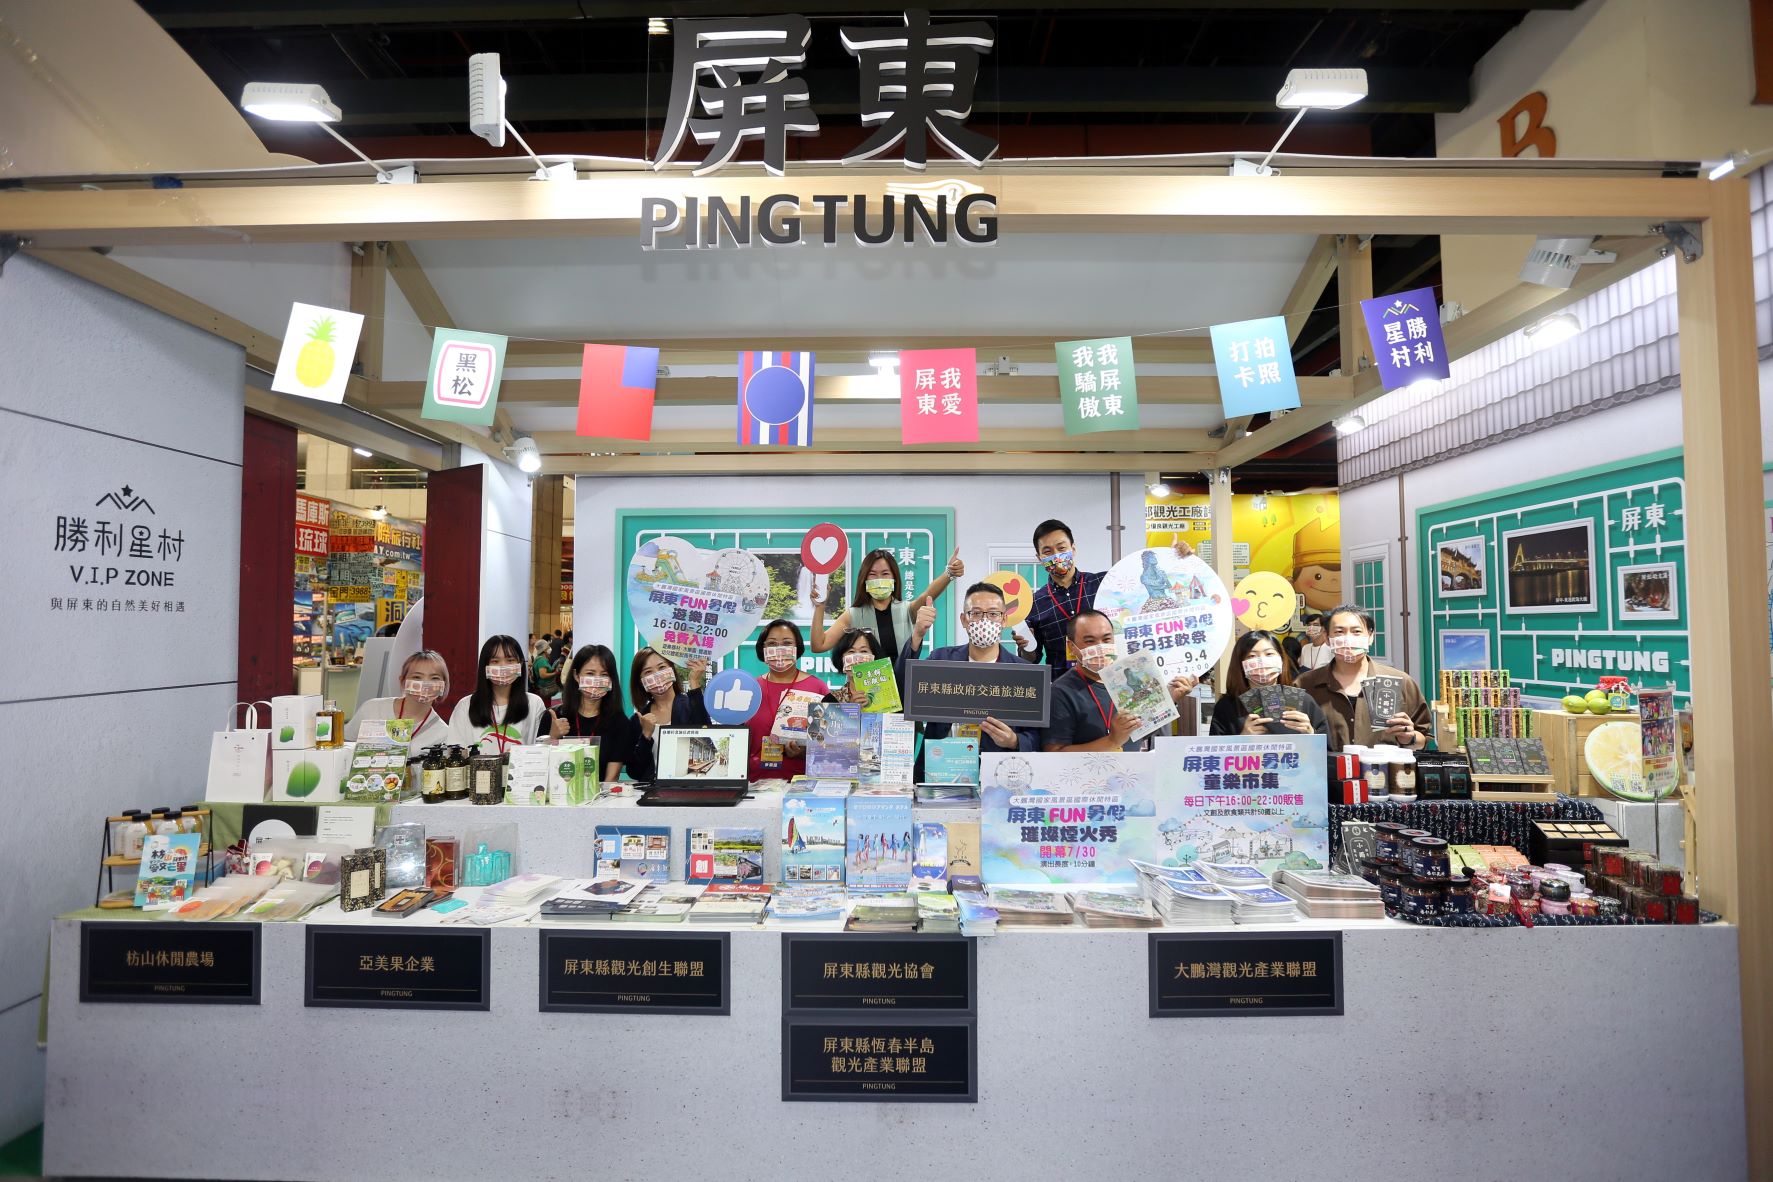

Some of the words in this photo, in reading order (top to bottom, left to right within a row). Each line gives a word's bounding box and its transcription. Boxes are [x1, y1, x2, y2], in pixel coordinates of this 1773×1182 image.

[653, 8, 1000, 177] 屏東
[451, 352, 477, 397] 黑松
[1622, 503, 1667, 532] 屏東
[55, 515, 185, 562] 勝利星村
[295, 528, 328, 554] 琉球
[375, 521, 423, 550] 際旅行社
[70, 565, 118, 586] V.I.P
[125, 569, 175, 586] ZONE
[51, 597, 186, 613] 與屏東的自然美好相遇
[663, 630, 715, 648] 免費入場
[1551, 648, 1669, 673] PINGTUNG
[917, 681, 1037, 699] 屏東縣政府交通旅遊處
[1203, 772, 1279, 790] 童樂市集
[1020, 825, 1118, 843] 璀璨煙火秀
[126, 950, 215, 967] 枋山休閒農場
[359, 954, 435, 973] 亞美果企業
[564, 958, 705, 978] 屏東縣觀光創生聯盟
[823, 962, 935, 980] 屏東縣觀光協會
[1174, 961, 1318, 979] 大鵬灣觀光產業聯盟
[823, 1037, 935, 1055] 屏東縣恆春半島
[831, 1057, 927, 1074] 觀光產業聯盟
